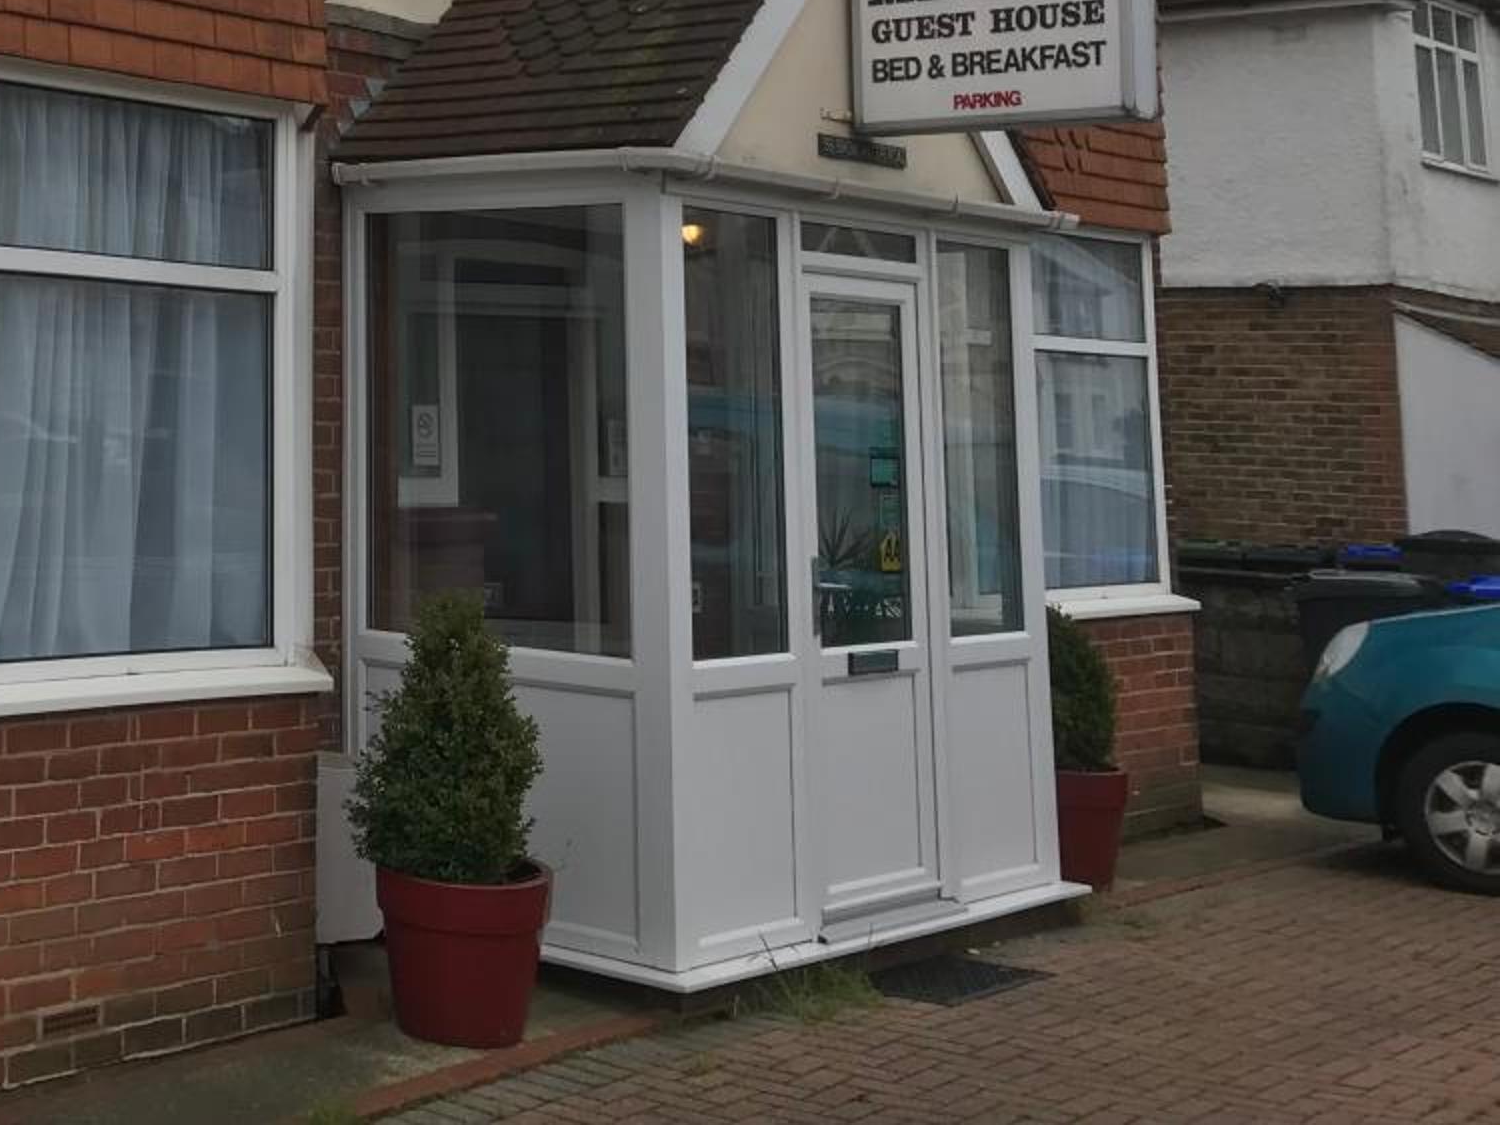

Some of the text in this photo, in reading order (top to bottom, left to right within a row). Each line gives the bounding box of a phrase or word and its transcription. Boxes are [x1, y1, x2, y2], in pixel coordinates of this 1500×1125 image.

[871, 0, 1105, 44] GUEST HOUSE
[872, 40, 1107, 83] BED & BREAKFAST
[952, 90, 1023, 111] PARKING
